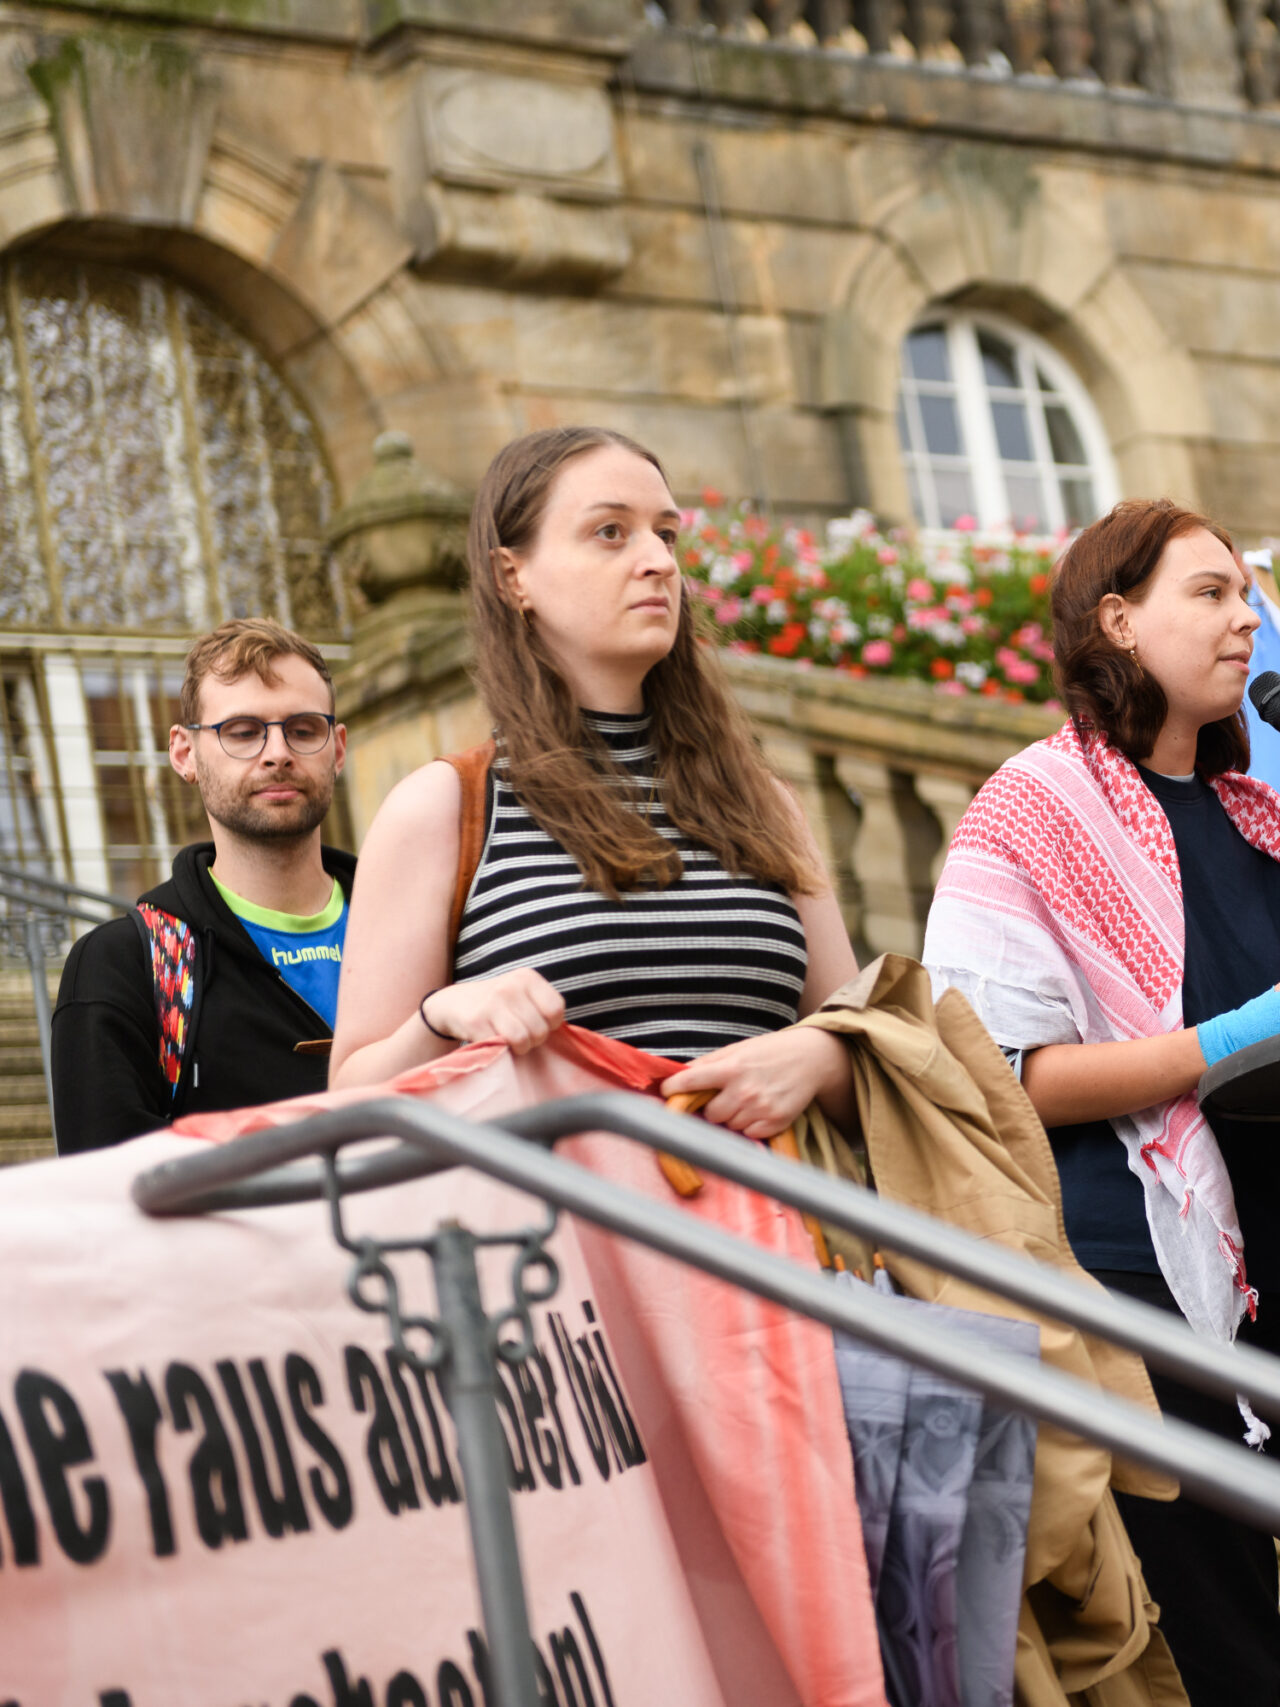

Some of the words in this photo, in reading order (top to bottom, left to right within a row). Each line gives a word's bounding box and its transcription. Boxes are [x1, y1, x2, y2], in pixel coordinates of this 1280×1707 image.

[271, 943, 342, 967] hummel
[103, 1351, 356, 1559] raus
[343, 1344, 464, 1517] au
